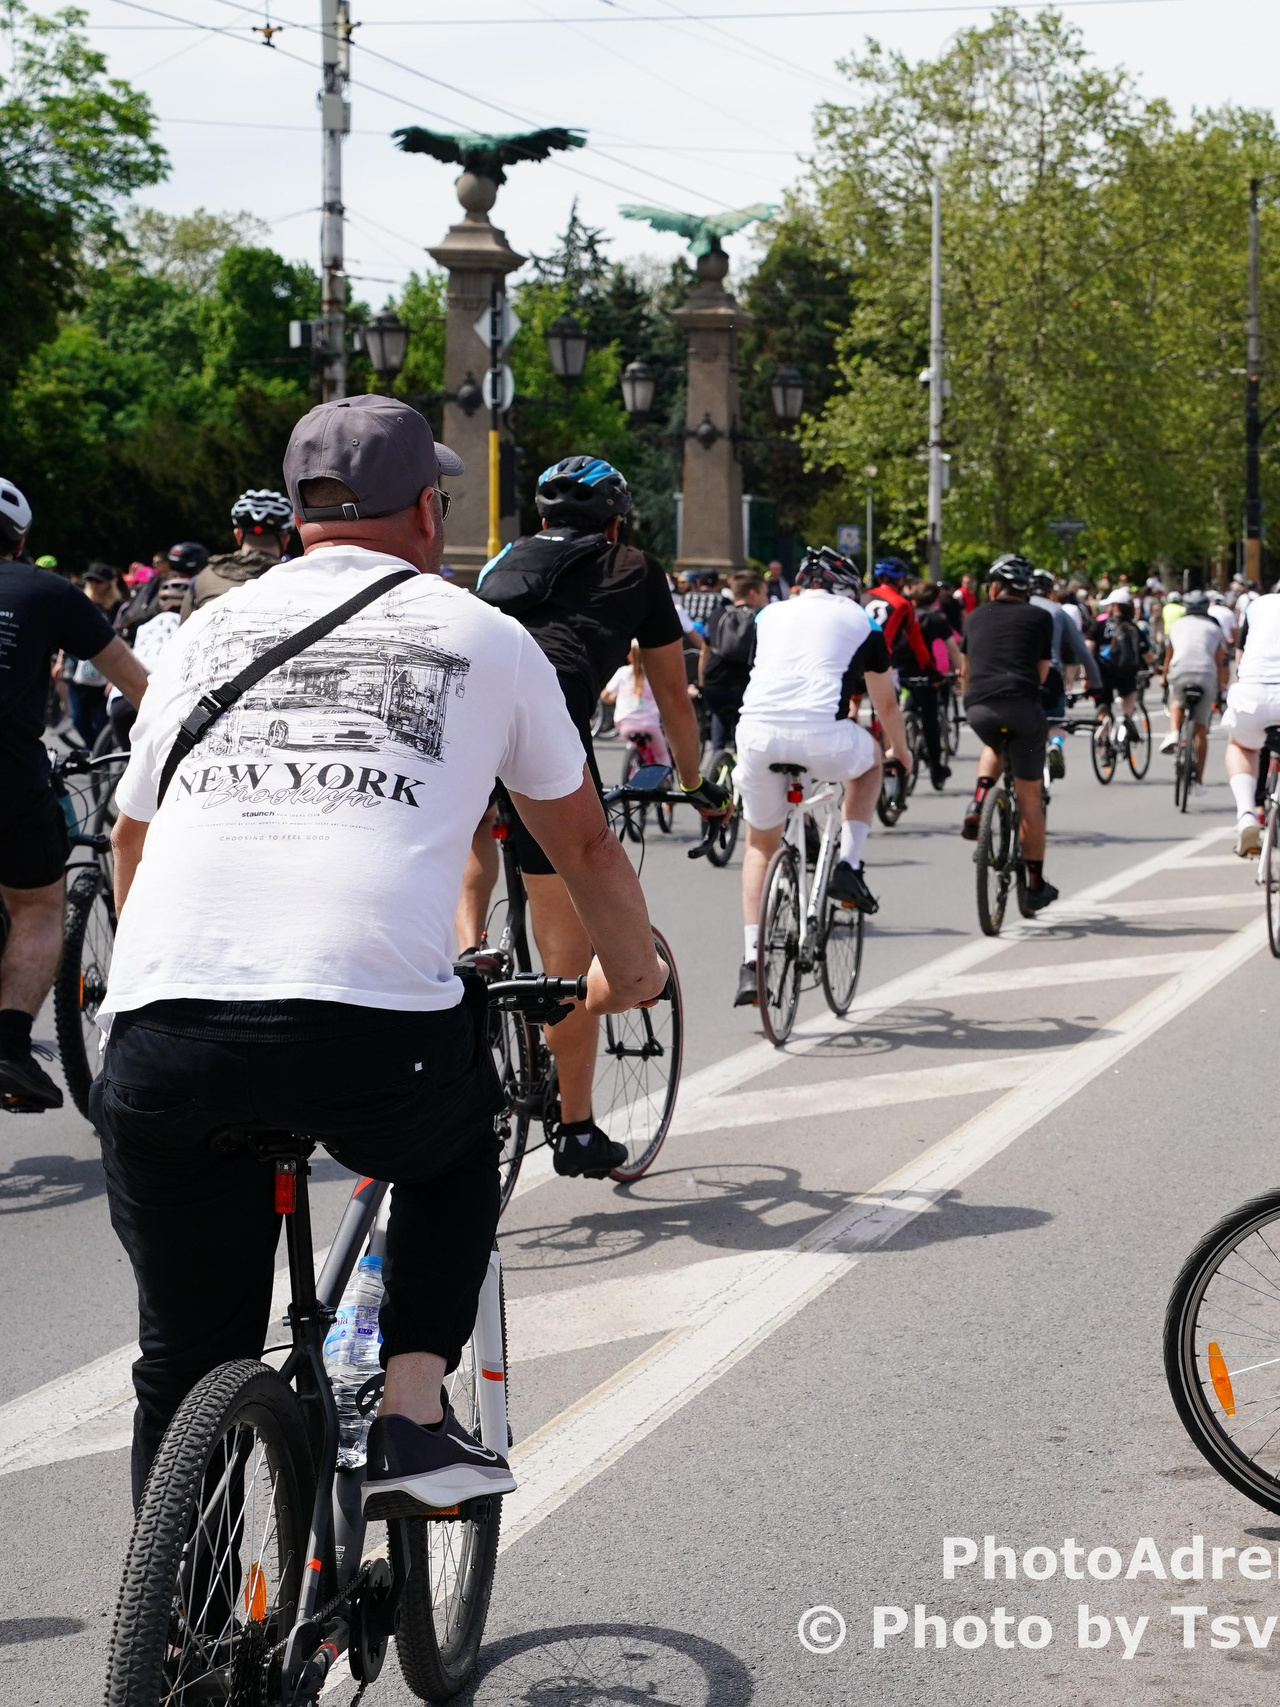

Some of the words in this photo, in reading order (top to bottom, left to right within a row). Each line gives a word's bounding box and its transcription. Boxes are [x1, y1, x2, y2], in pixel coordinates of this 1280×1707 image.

[175, 764, 273, 802] NEW
[283, 763, 425, 808] YORK
[202, 774, 381, 814] Brooklyn
